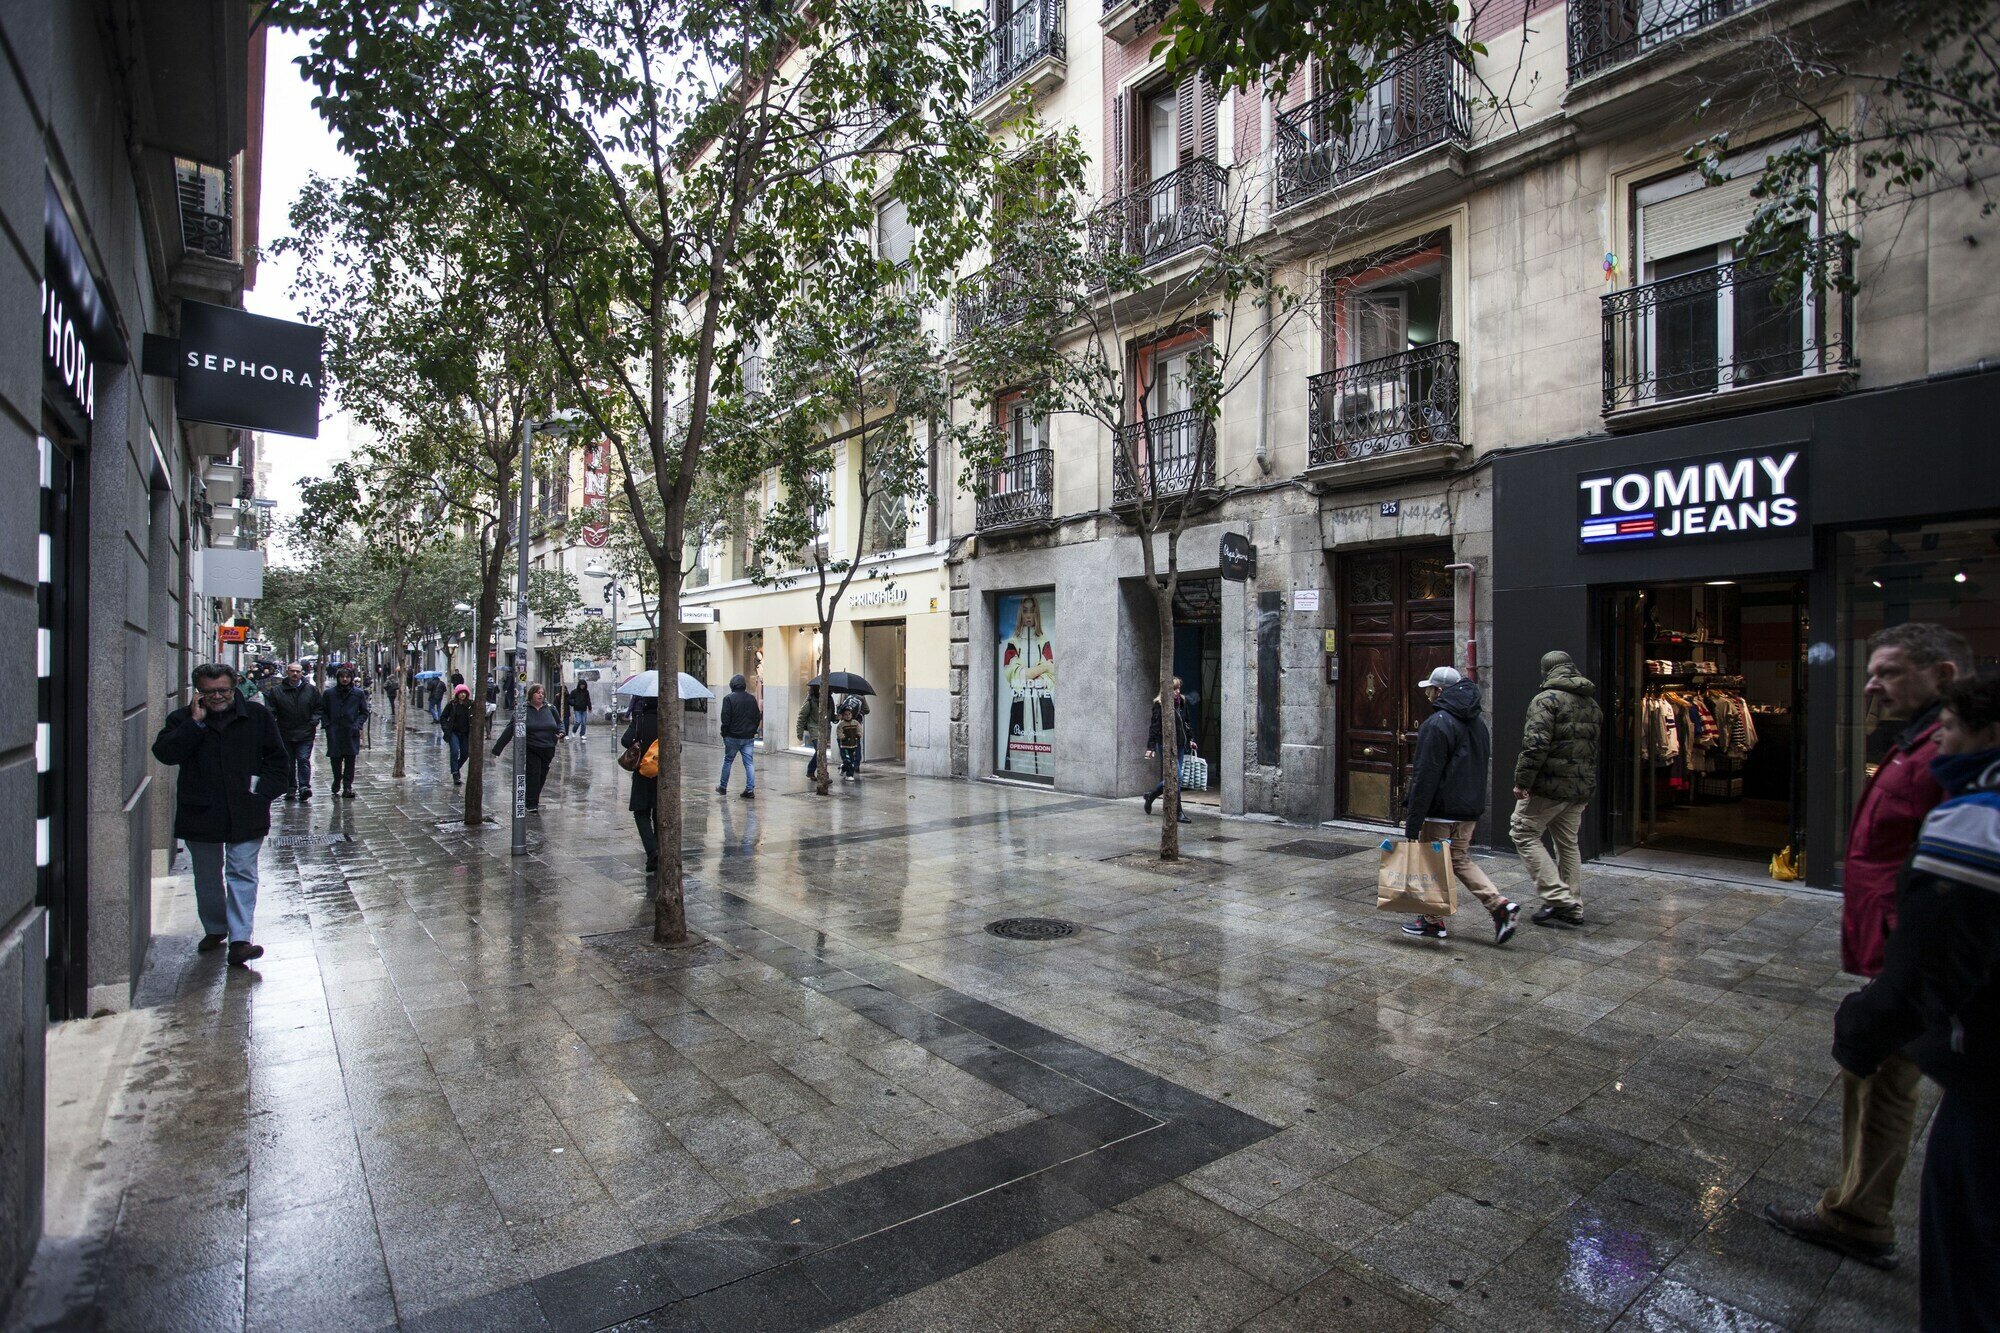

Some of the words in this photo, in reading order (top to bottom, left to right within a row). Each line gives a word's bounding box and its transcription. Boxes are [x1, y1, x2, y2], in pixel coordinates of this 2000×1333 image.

[187, 352, 313, 388] SEPHORA
[1580, 452, 1799, 515] TOMMY
[1382, 502, 1397, 514] 23
[1661, 498, 1798, 537] JEANS
[848, 589, 907, 606] SPRINGFIELD
[1010, 743, 1034, 751] OPENING
[1387, 871, 1438, 882] PRIMARK
